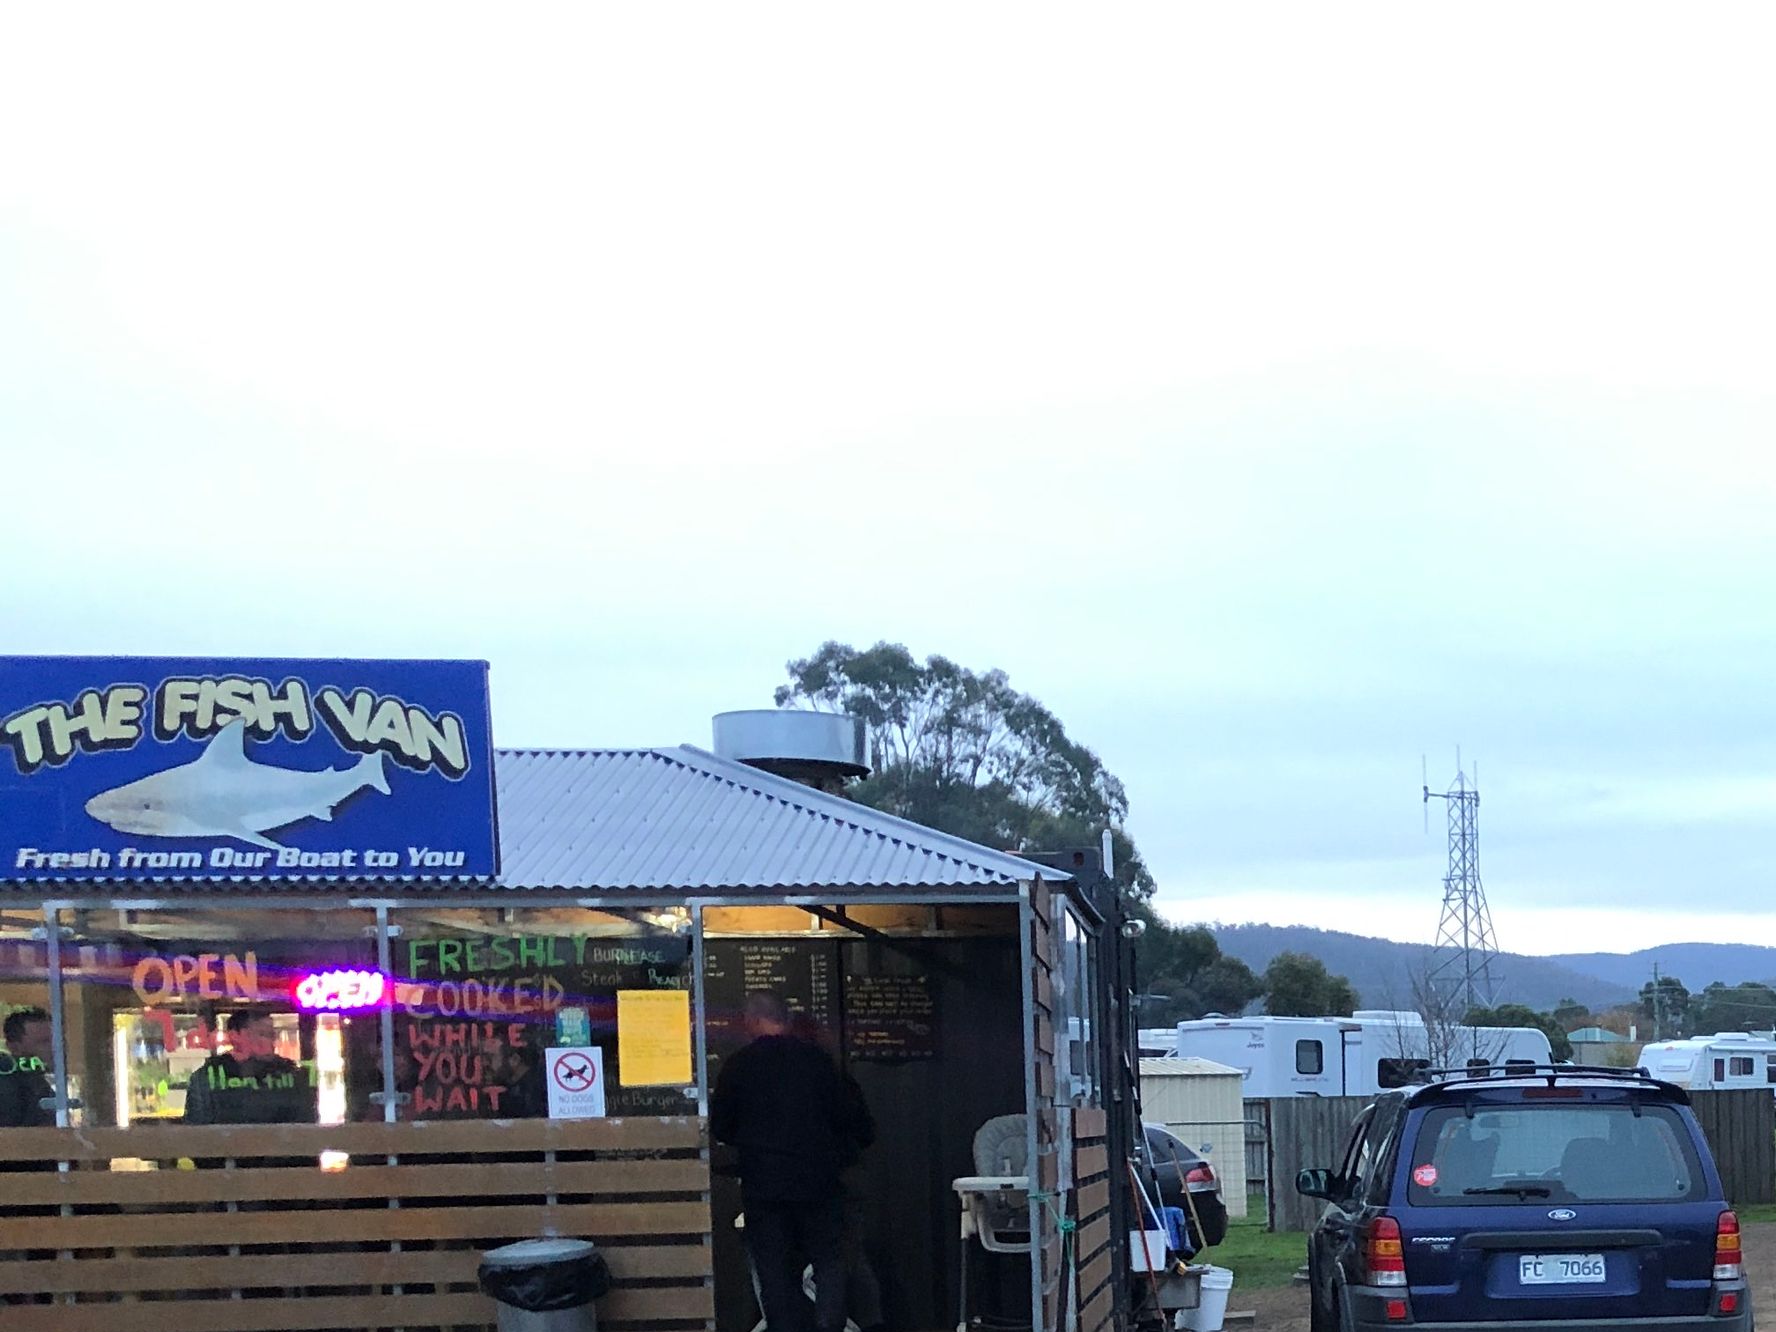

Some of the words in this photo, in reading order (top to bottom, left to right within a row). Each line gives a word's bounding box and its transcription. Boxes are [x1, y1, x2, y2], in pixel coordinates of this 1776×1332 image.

[4, 684, 148, 770] THE
[158, 677, 314, 740] FISH
[318, 688, 469, 778] VAN
[15, 847, 110, 869] Fresh
[118, 847, 202, 868] from
[210, 846, 271, 868] Our
[277, 846, 357, 868] Boat
[364, 847, 399, 867] to
[408, 847, 465, 867] You
[408, 932, 588, 978] FRESHLY
[131, 950, 258, 1003] OPEN
[296, 969, 385, 1010] OPEN
[408, 1022, 528, 1049] WHILE
[413, 1051, 483, 1085] YOU
[414, 1086, 507, 1113] WAIT
[1522, 1260, 1544, 1277] FC
[1559, 1260, 1603, 1277] 7066
